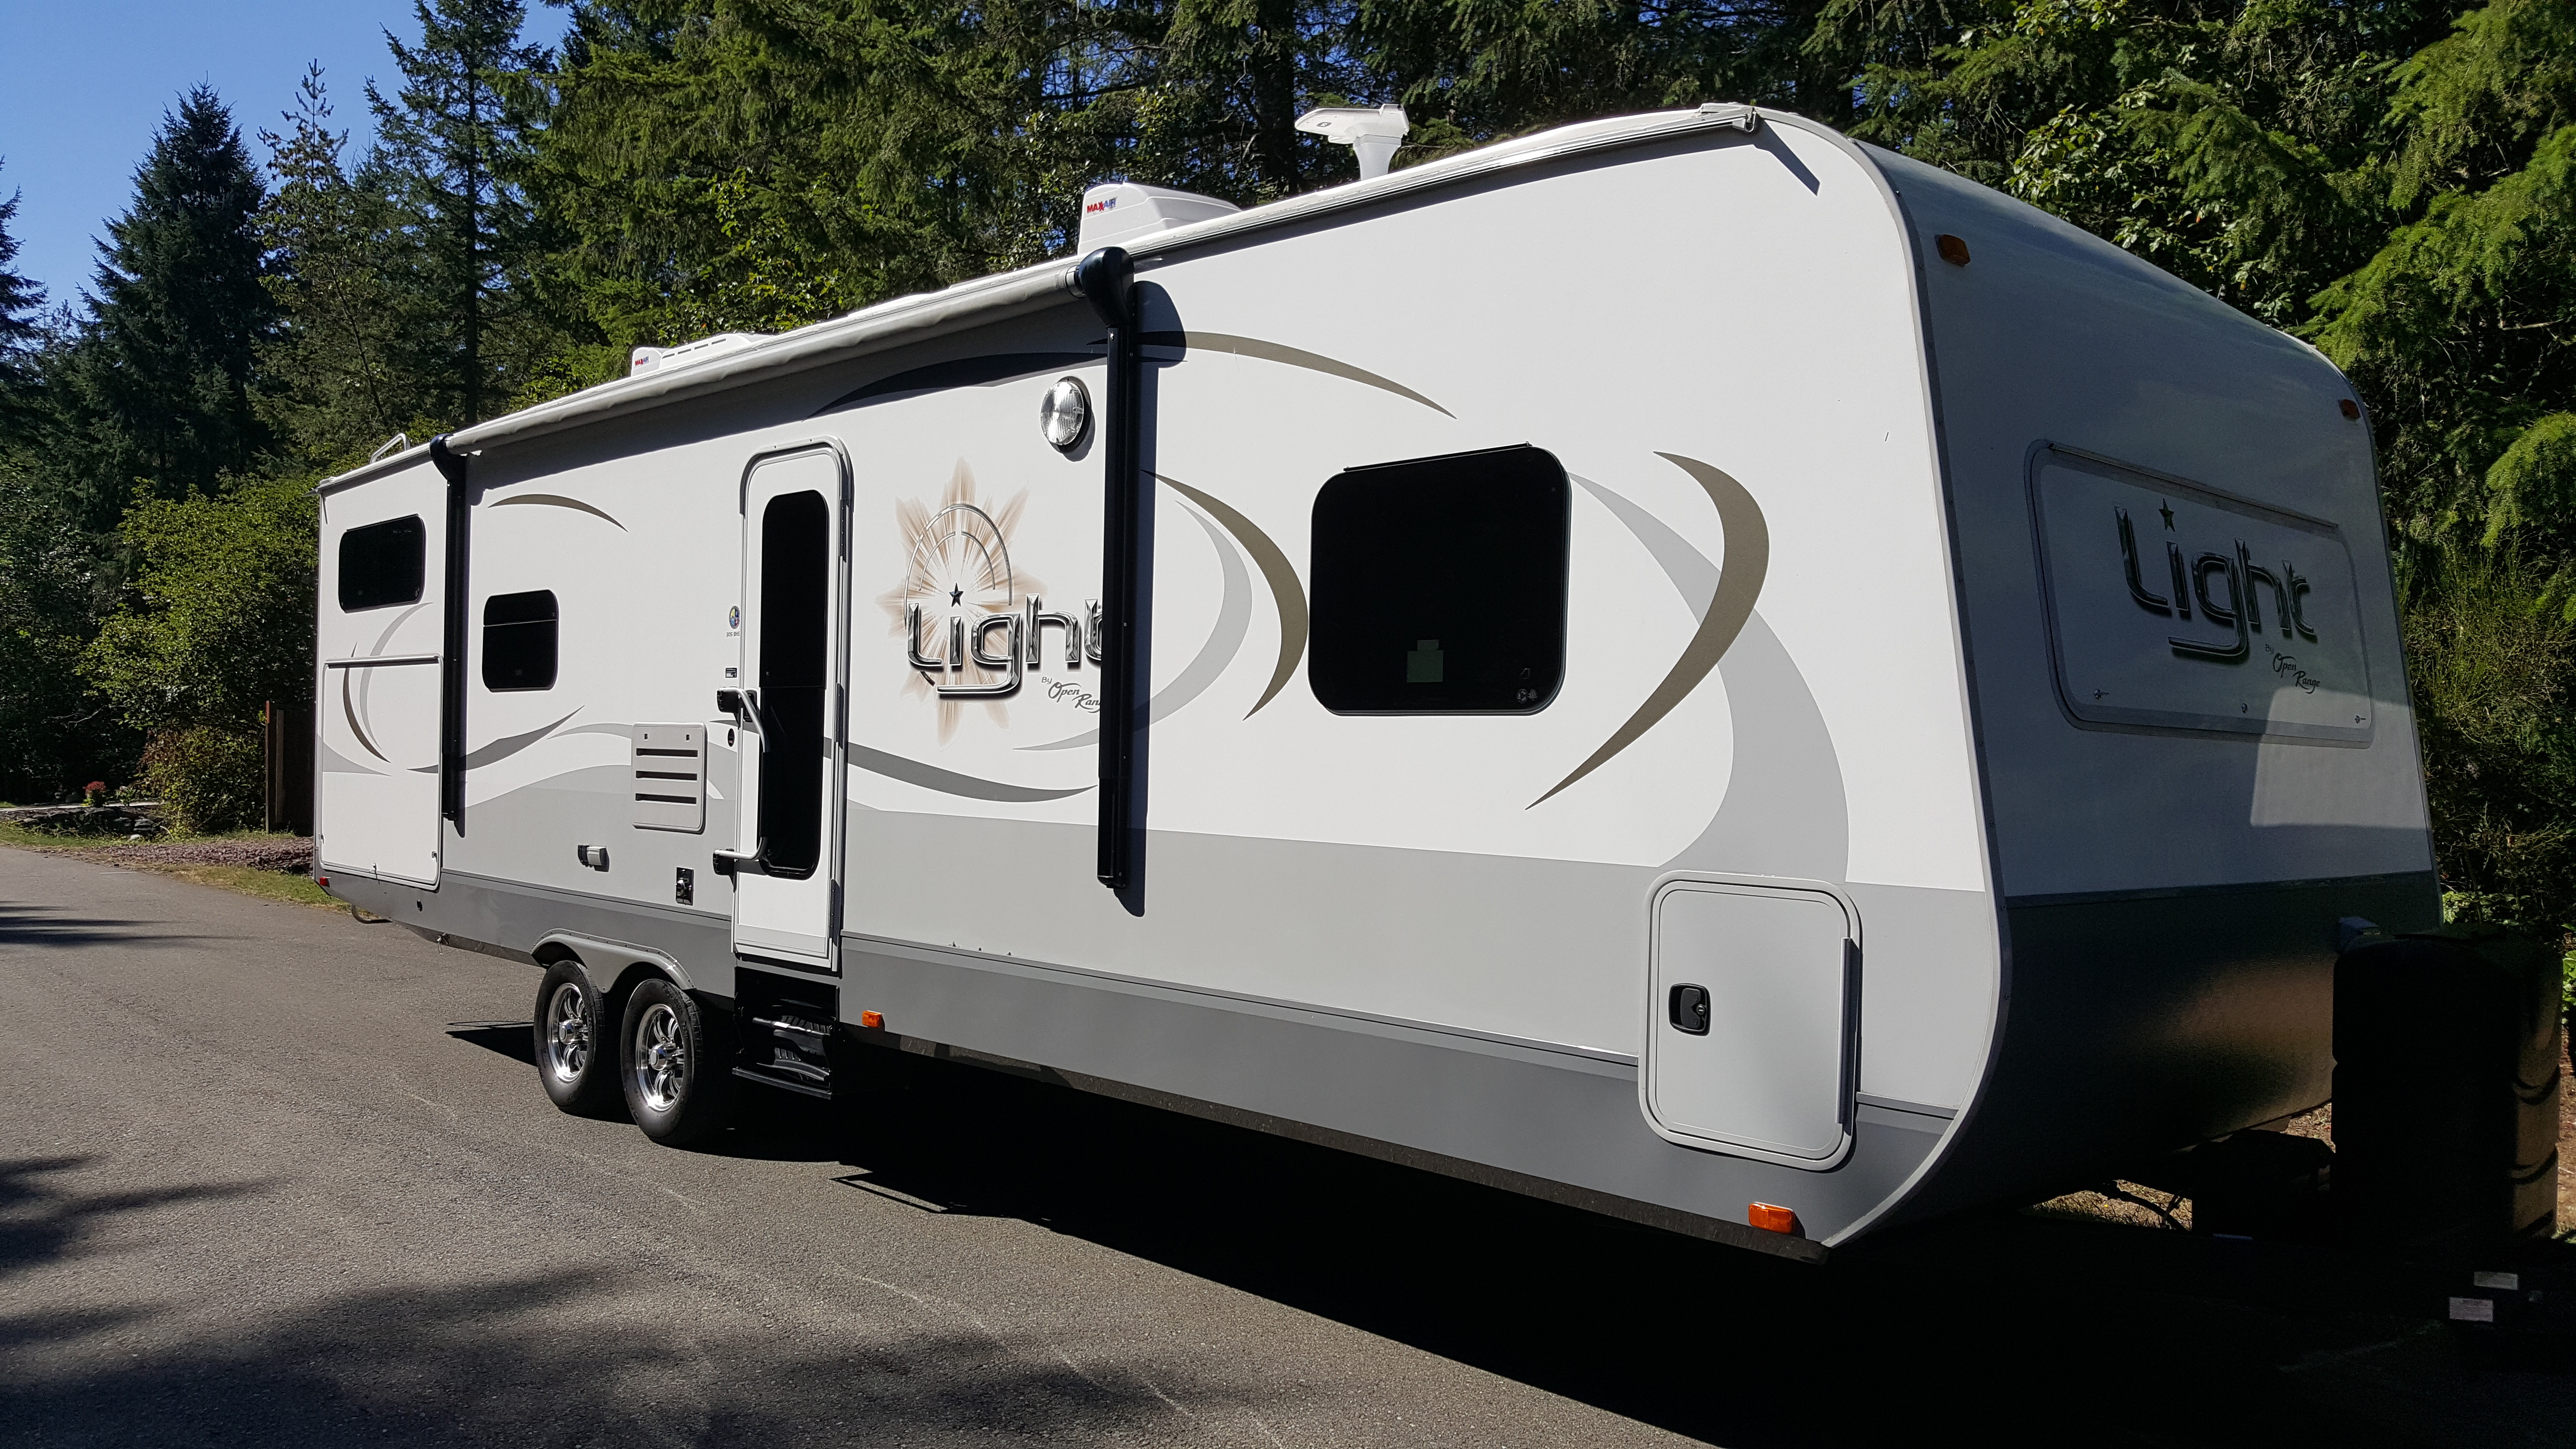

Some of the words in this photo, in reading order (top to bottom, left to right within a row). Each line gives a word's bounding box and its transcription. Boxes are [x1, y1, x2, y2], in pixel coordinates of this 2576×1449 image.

[2114, 499, 2316, 658] Light
[2265, 644, 2274, 654] By
[2273, 652, 2297, 678] Open
[1048, 681, 1082, 703] Open
[2292, 670, 2321, 694] Range
[1071, 693, 1100, 713] Ran
